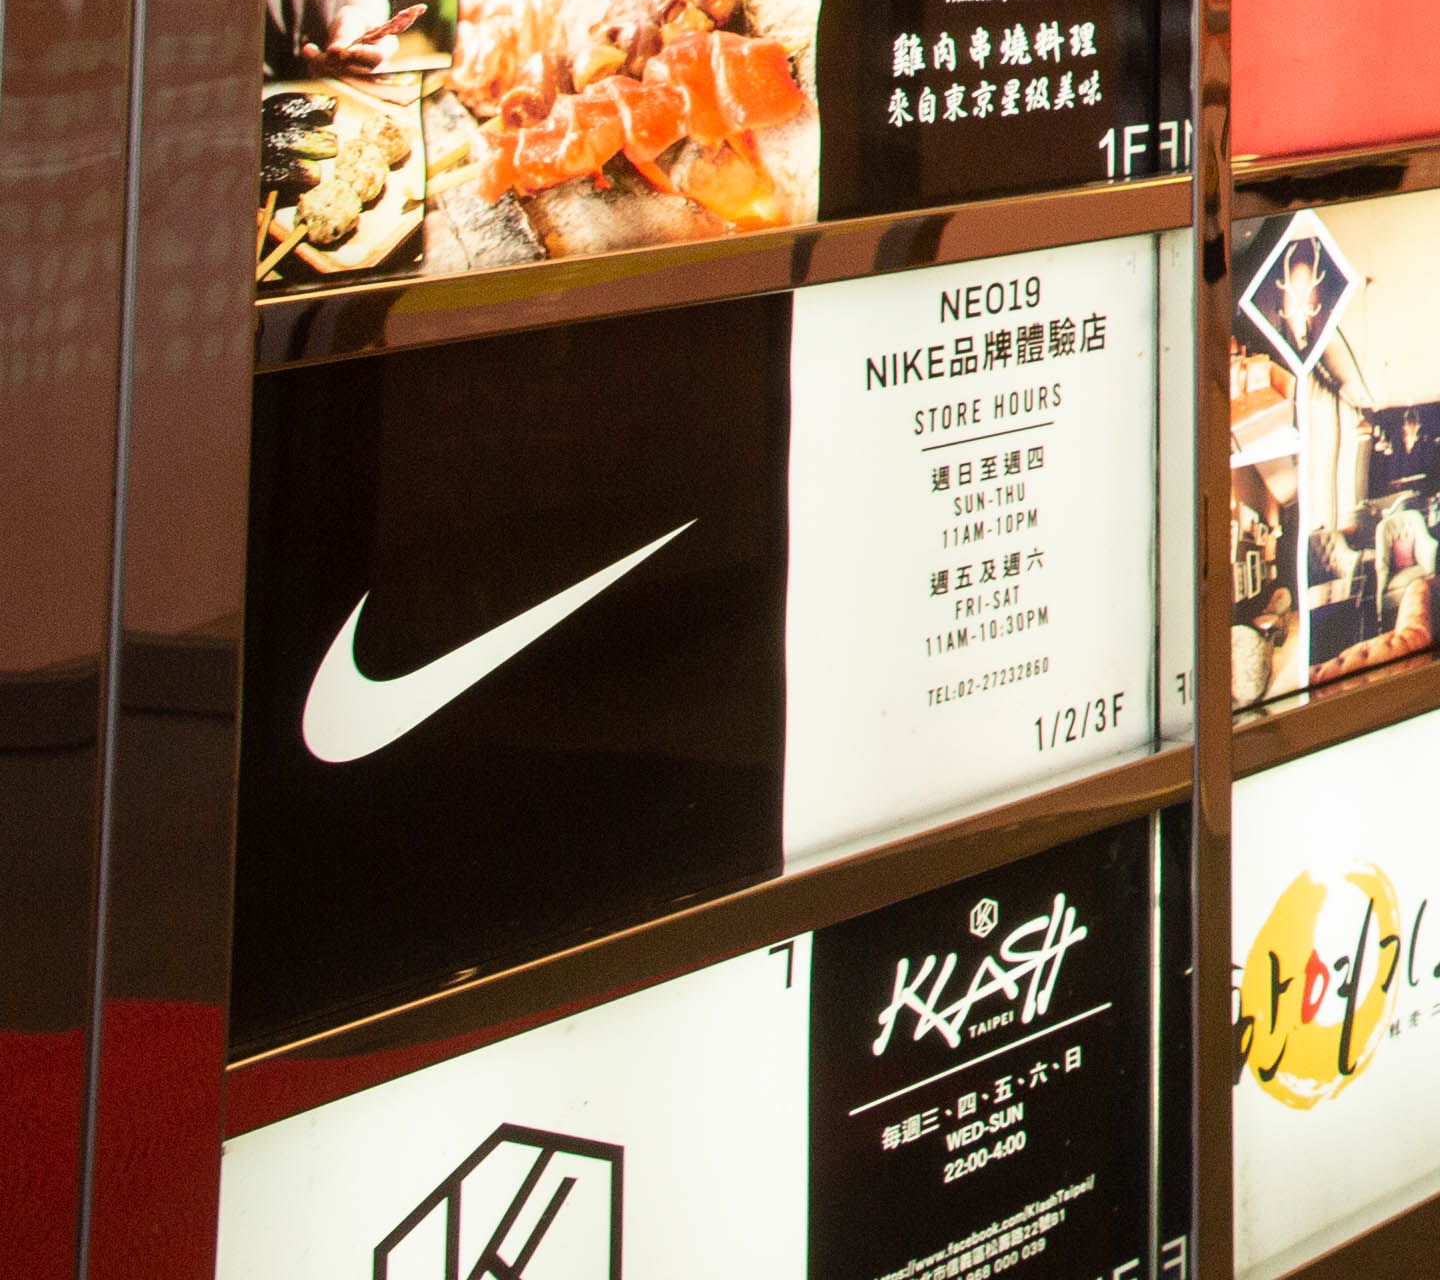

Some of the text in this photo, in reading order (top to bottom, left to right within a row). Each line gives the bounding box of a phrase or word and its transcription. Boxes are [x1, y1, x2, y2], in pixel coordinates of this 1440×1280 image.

[893, 21, 1098, 79] 雞肉串燒料理
[888, 70, 1102, 127] 來自東京星級美味
[1099, 124, 1149, 179] 1F
[940, 276, 1042, 324] NEO19
[866, 312, 1108, 392] NIKE品牌體驗店
[914, 383, 1064, 436] STORE HOURS
[931, 446, 1046, 493] 週日至週四
[954, 482, 1026, 518] SUN-THU
[942, 509, 1039, 549] 11AM-10PM
[930, 547, 1046, 598] 週五及週六
[955, 585, 1021, 621] FRI-SAT
[926, 605, 1050, 657] 11AM-10:30PM
[928, 656, 1051, 707] TEL:02-27232860
[1034, 691, 1126, 754] 1/2/3F
[968, 1011, 1015, 1039] TAIPEI
[945, 1103, 1025, 1152] WED-SUN
[944, 1131, 1027, 1184] 22:00-4:00
